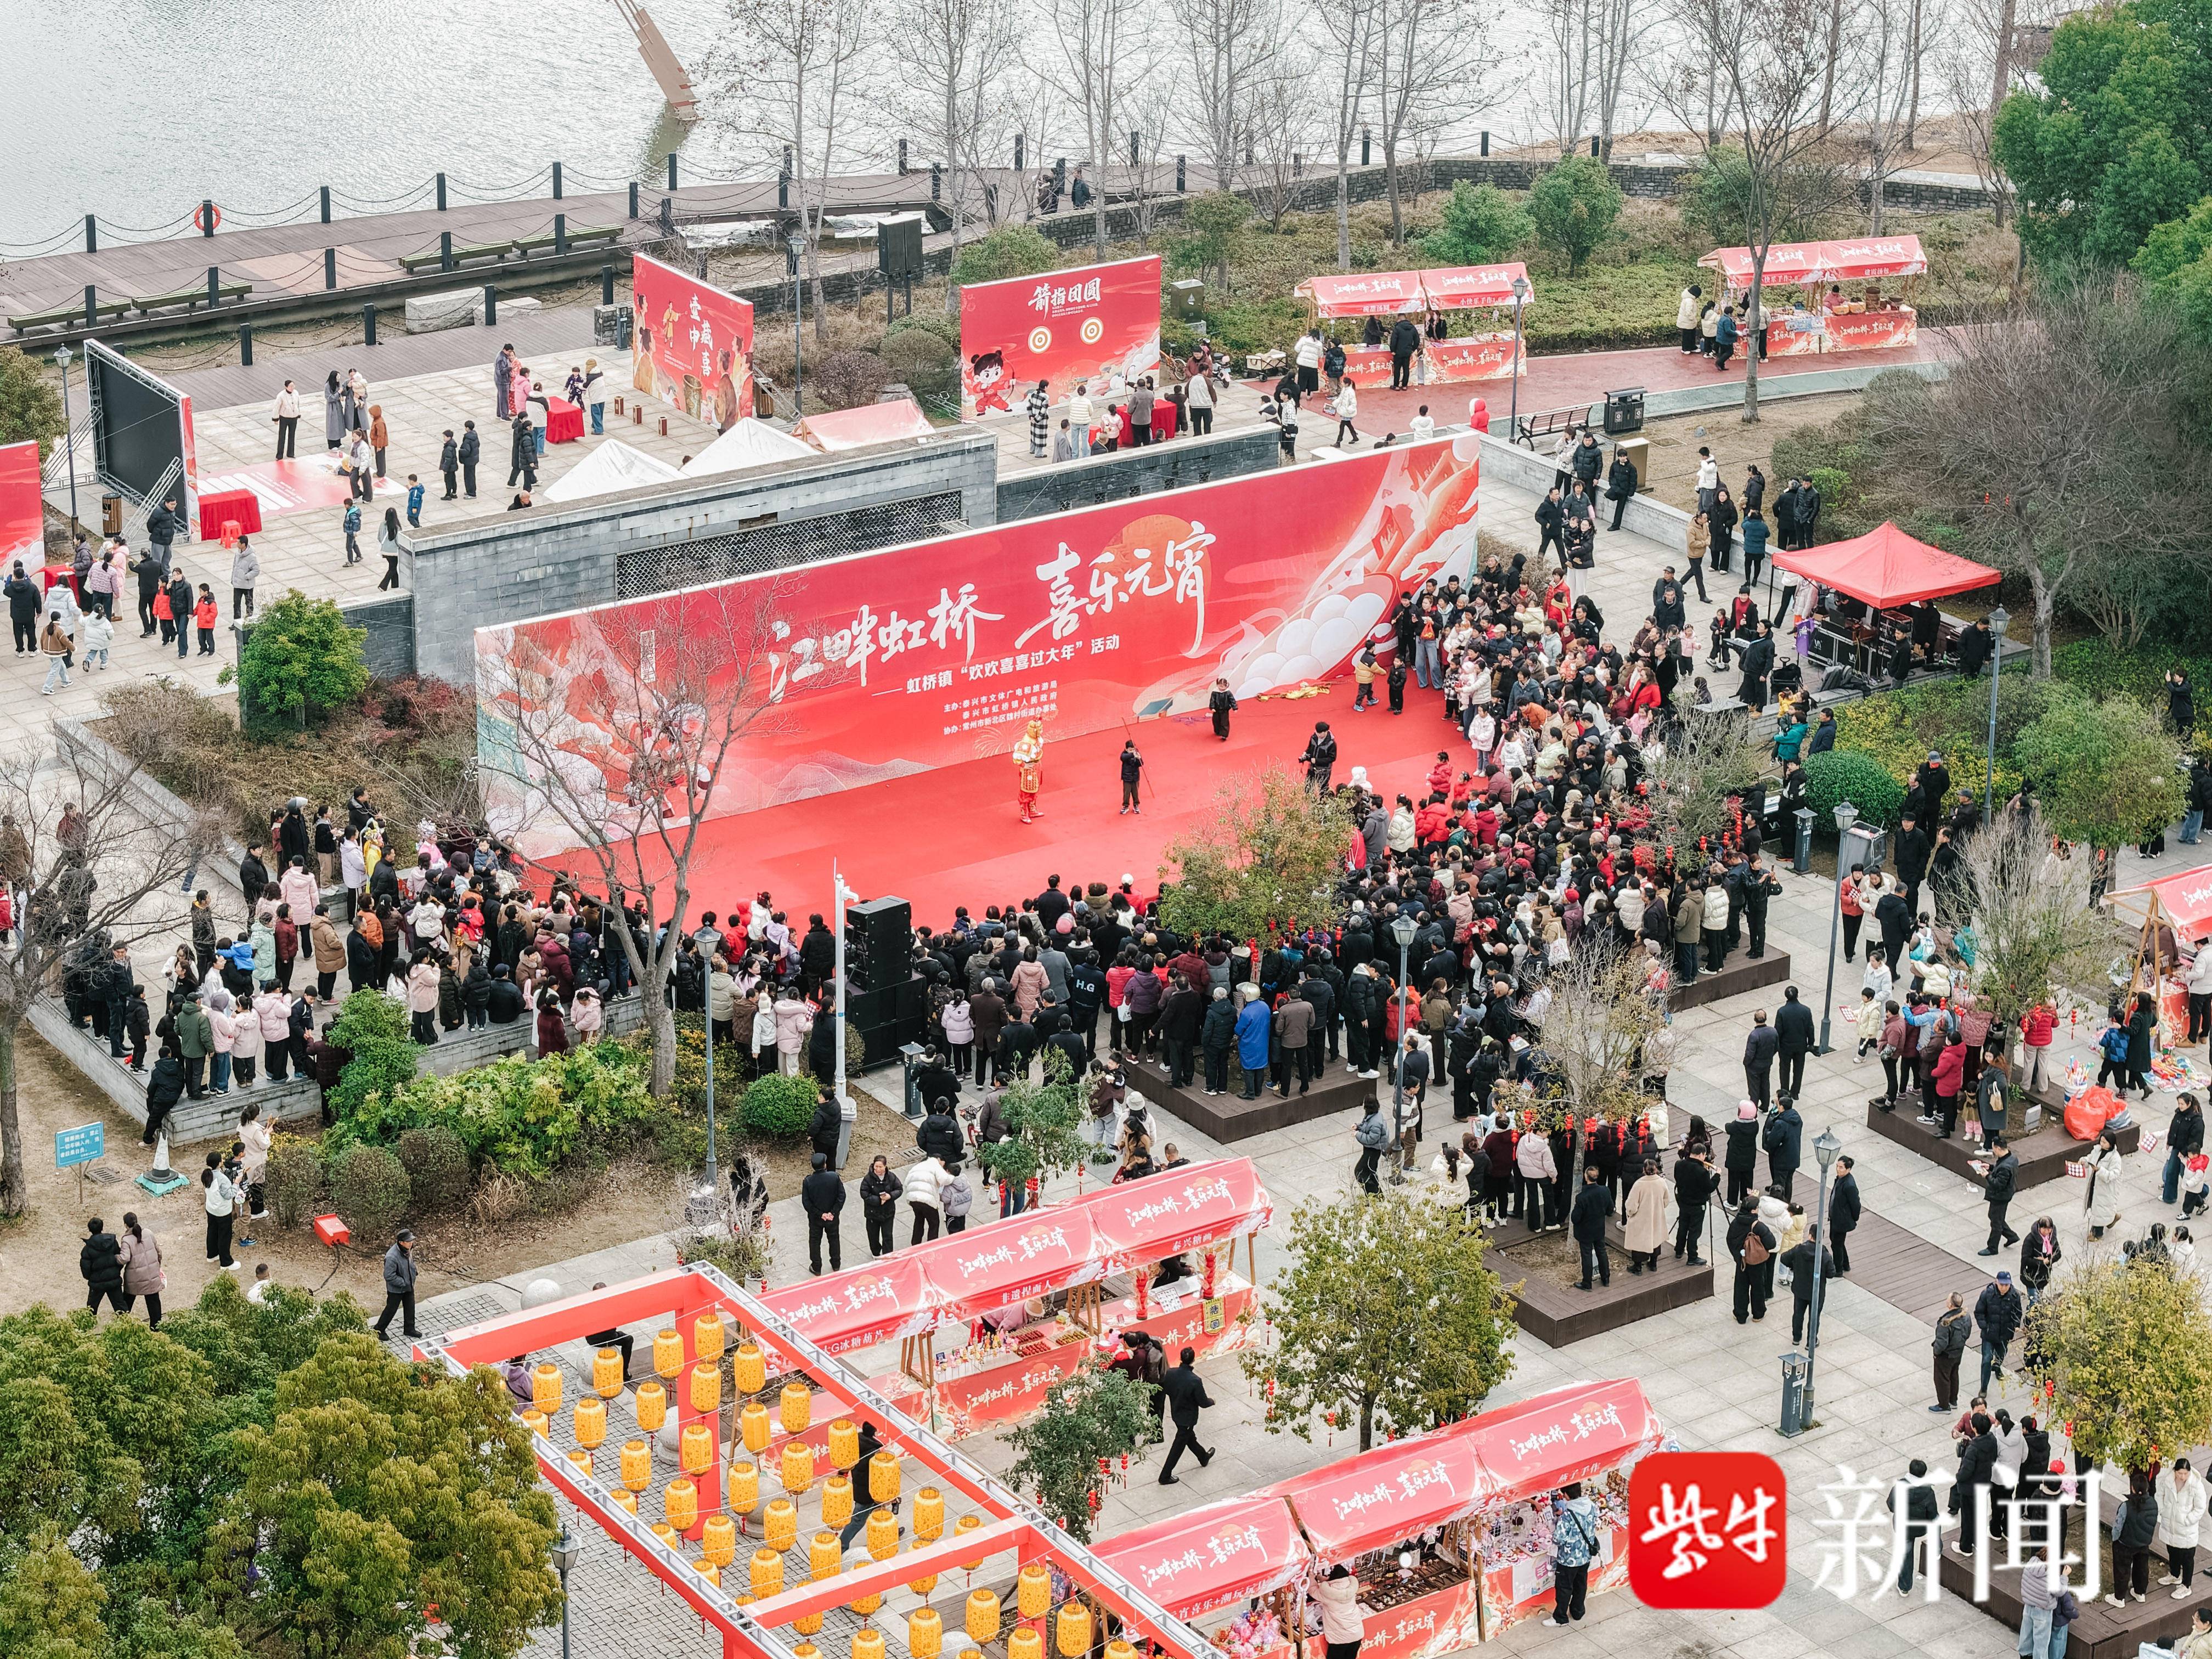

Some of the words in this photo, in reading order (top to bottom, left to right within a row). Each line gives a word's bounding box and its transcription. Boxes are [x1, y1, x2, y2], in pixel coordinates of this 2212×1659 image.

[1028, 277, 1101, 321] 箭指团圆
[769, 582, 1005, 704] 江畔虹桥
[1015, 520, 1216, 658] 喜乐元宵
[1076, 979, 1095, 992] H.G
[1125, 1196, 1183, 1228] 江畔虹桥
[1183, 1178, 1236, 1212] 喜乐元宵
[957, 1245, 1017, 1278] 江畔虹桥
[1017, 1226, 1072, 1262] 喜乐元宵
[780, 1295, 843, 1325] 江畔虹桥
[844, 1276, 900, 1313] 喜乐元宵
[966, 1380, 1019, 1413] 江畔虹桥
[1509, 1424, 1570, 1461] 江畔虹桥
[1570, 1402, 1627, 1442] 喜乐元宵
[1332, 1482, 1396, 1521] 江畔虹桥
[1396, 1460, 1455, 1501] 喜乐元宵
[1139, 1548, 1206, 1588] 江畔虹桥
[1207, 1525, 1268, 1568] 喜乐元宵
[1391, 1610, 1437, 1645] 喜乐元宵
